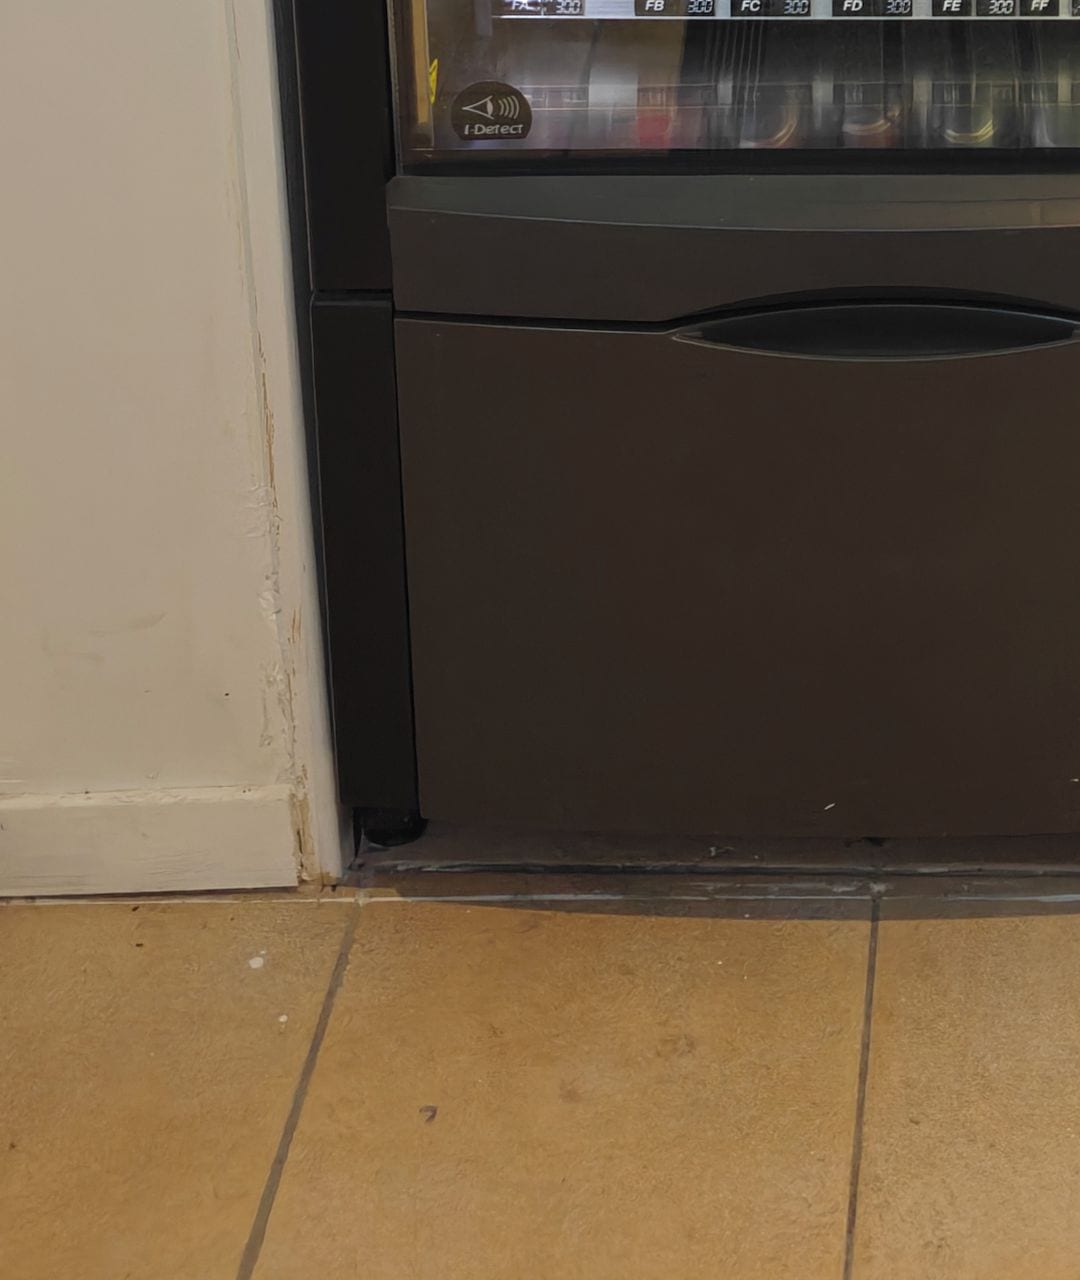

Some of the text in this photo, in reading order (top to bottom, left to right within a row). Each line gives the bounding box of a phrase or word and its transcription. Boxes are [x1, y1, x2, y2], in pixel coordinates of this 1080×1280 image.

[556, 0, 581, 14] 300
[645, 0, 665, 11] FB
[741, 0, 761, 12] FC
[784, 0, 809, 14] 300
[842, 0, 863, 11] FD
[943, 0, 962, 11] FE
[988, 0, 1014, 14] 300
[1030, 0, 1050, 11] FF
